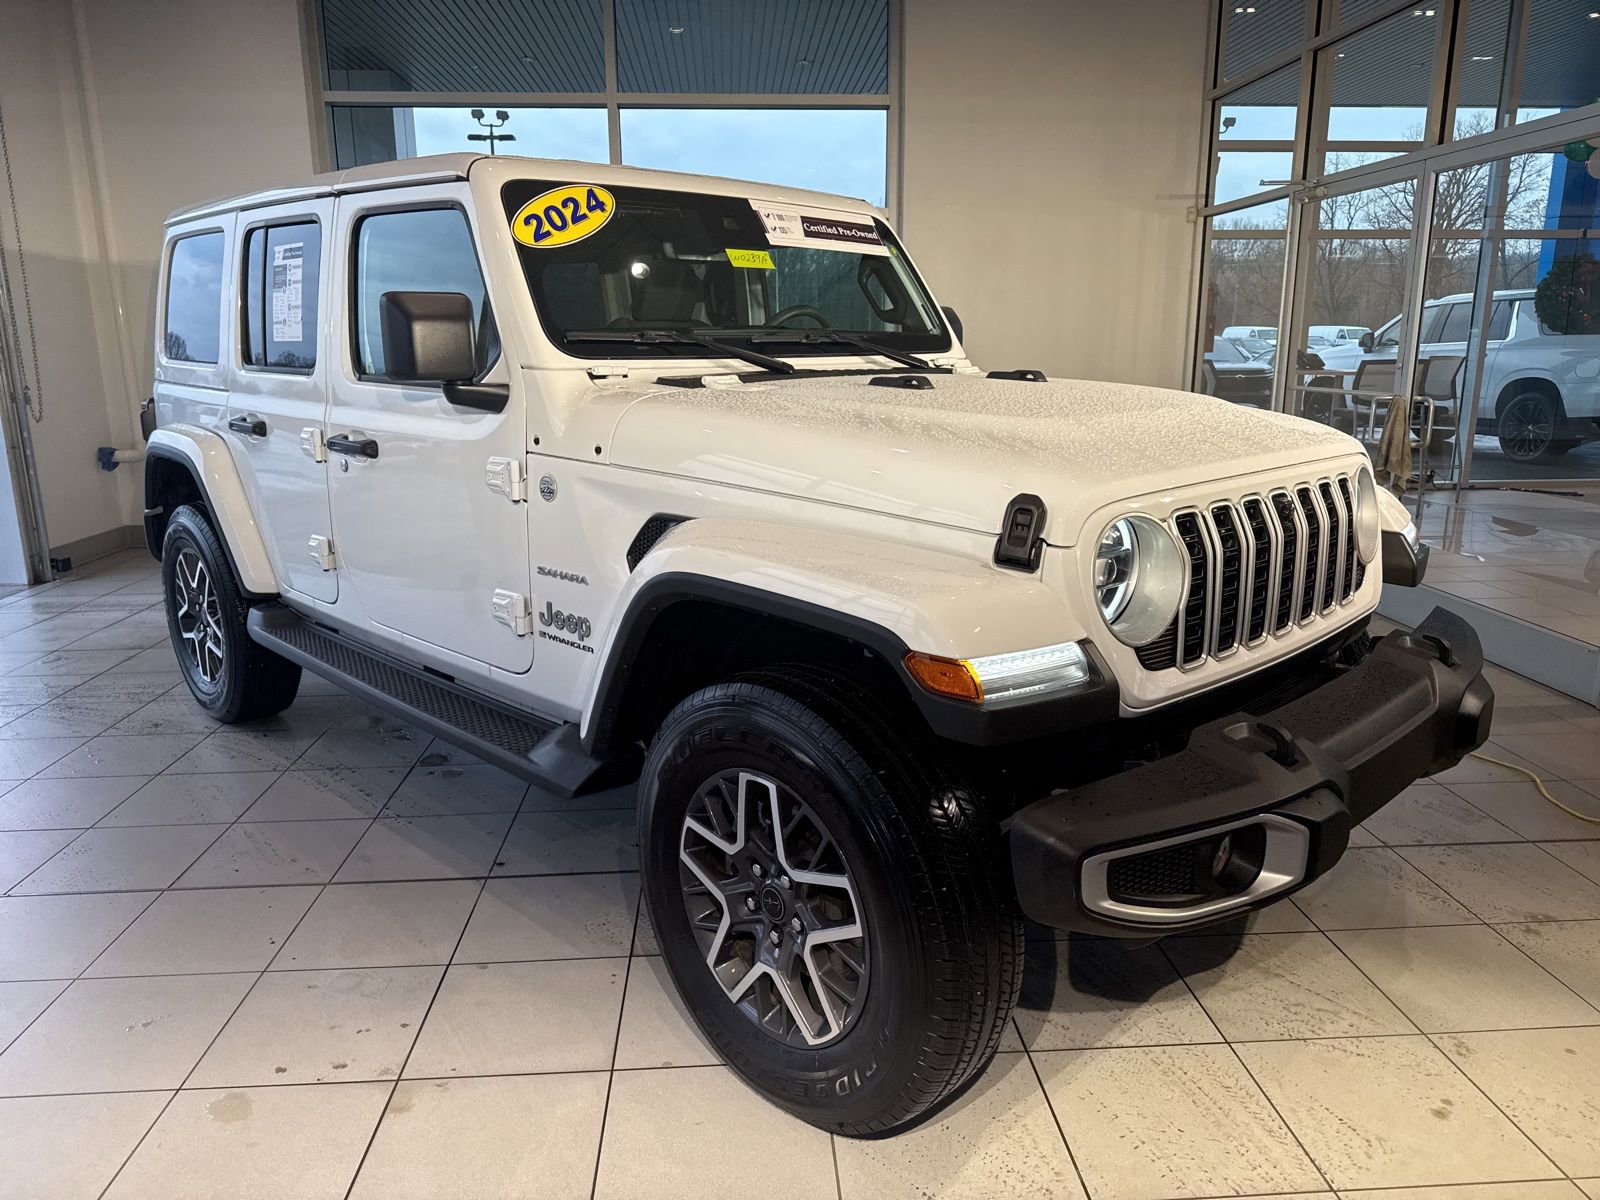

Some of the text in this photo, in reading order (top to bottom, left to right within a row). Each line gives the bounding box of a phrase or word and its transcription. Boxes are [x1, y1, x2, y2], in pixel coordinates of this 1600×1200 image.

[523, 187, 607, 244] 2024
[803, 222, 838, 235] Certified
[838, 227, 879, 240] Pre-Owned
[536, 565, 590, 586] SAHARA
[538, 600, 592, 642] Jeep
[546, 632, 595, 655] WRANGLER
